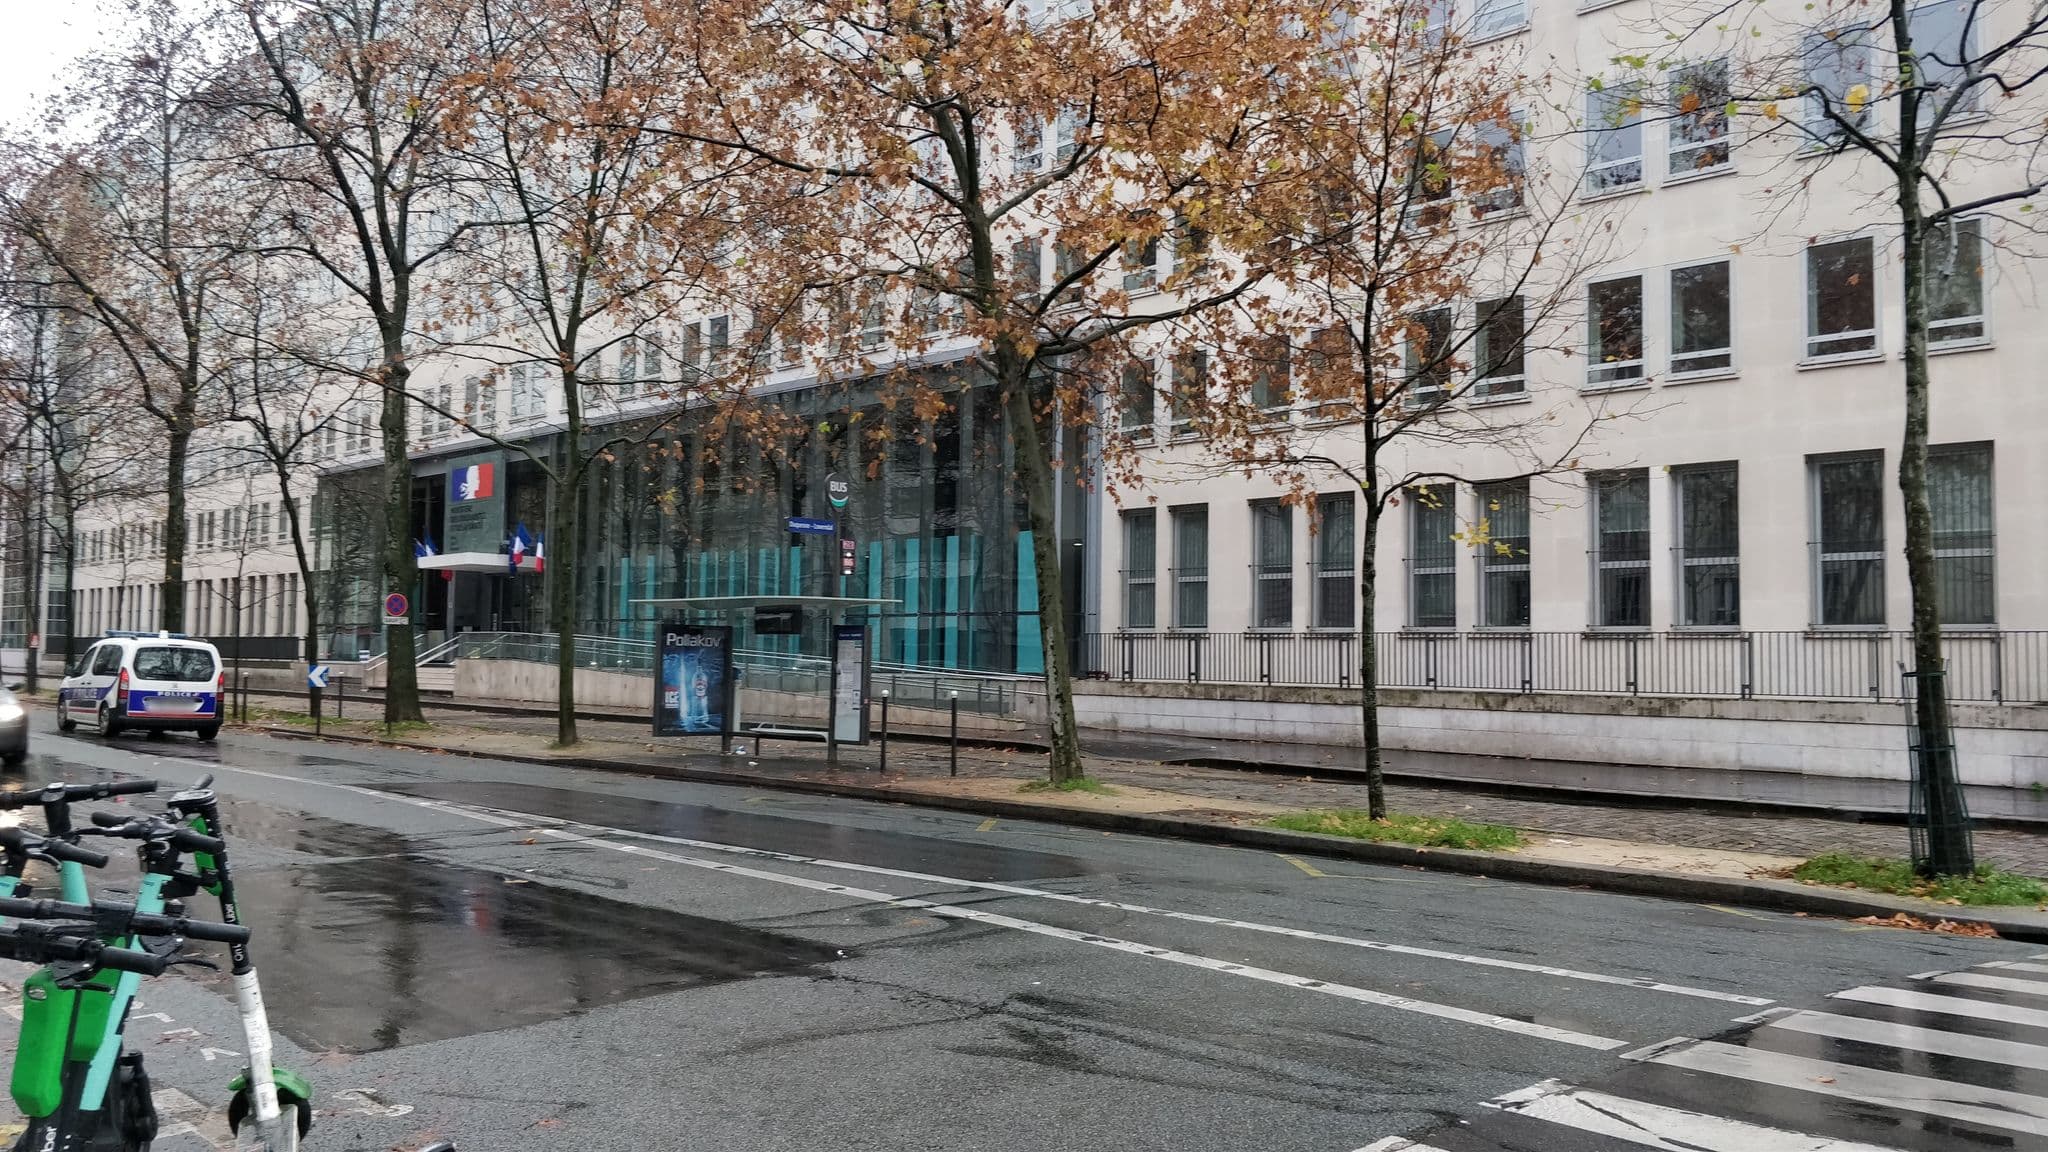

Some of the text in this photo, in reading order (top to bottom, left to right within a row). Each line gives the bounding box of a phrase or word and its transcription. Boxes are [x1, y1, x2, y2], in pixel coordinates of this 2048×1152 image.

[829, 480, 849, 492] BUS
[666, 632, 721, 648] Poliakov
[40, 1126, 58, 1152] ber
